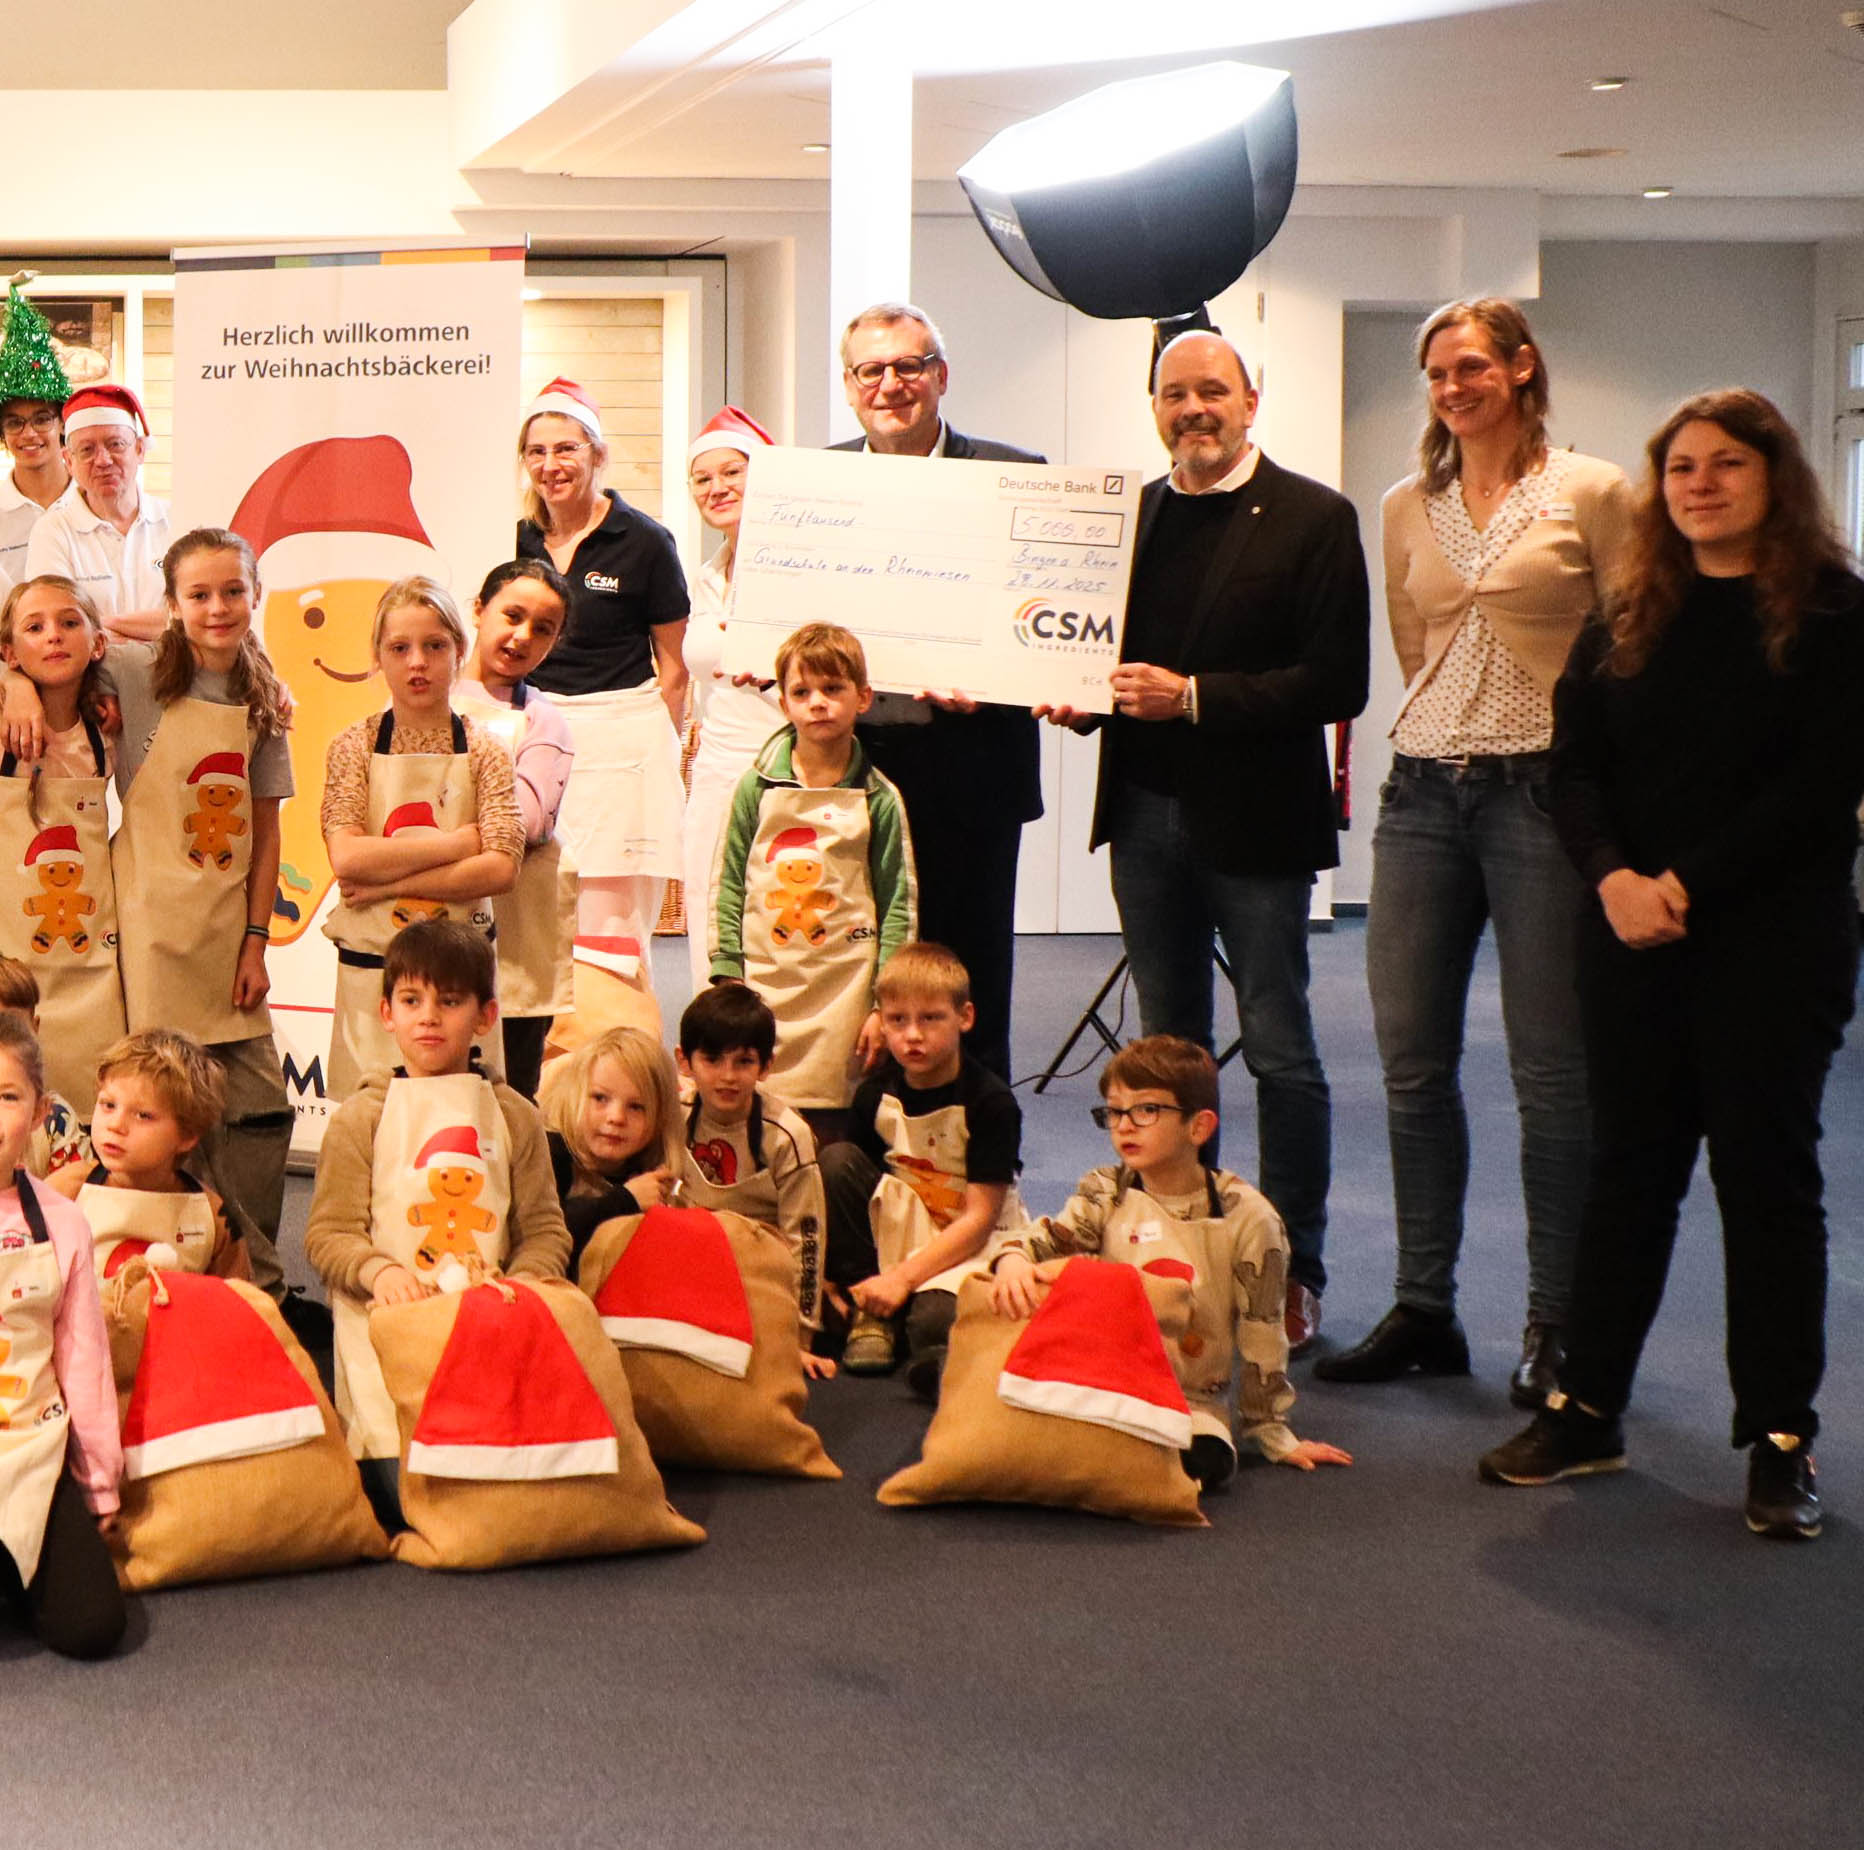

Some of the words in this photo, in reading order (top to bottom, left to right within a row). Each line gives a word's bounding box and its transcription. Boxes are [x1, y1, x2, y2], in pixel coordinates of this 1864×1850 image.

[222, 324, 315, 347] Herzlich
[323, 322, 470, 344] willkommen
[200, 362, 237, 380] zur
[244, 353, 492, 379] Weihnachtsbäckerei!
[998, 476, 1061, 492] Deutsche
[1064, 480, 1098, 495] Bank
[590, 575, 619, 589] CSM
[1031, 609, 1115, 645] CSM
[1032, 643, 1115, 656] INGREDIENTS
[42, 1402, 63, 1421] CS
